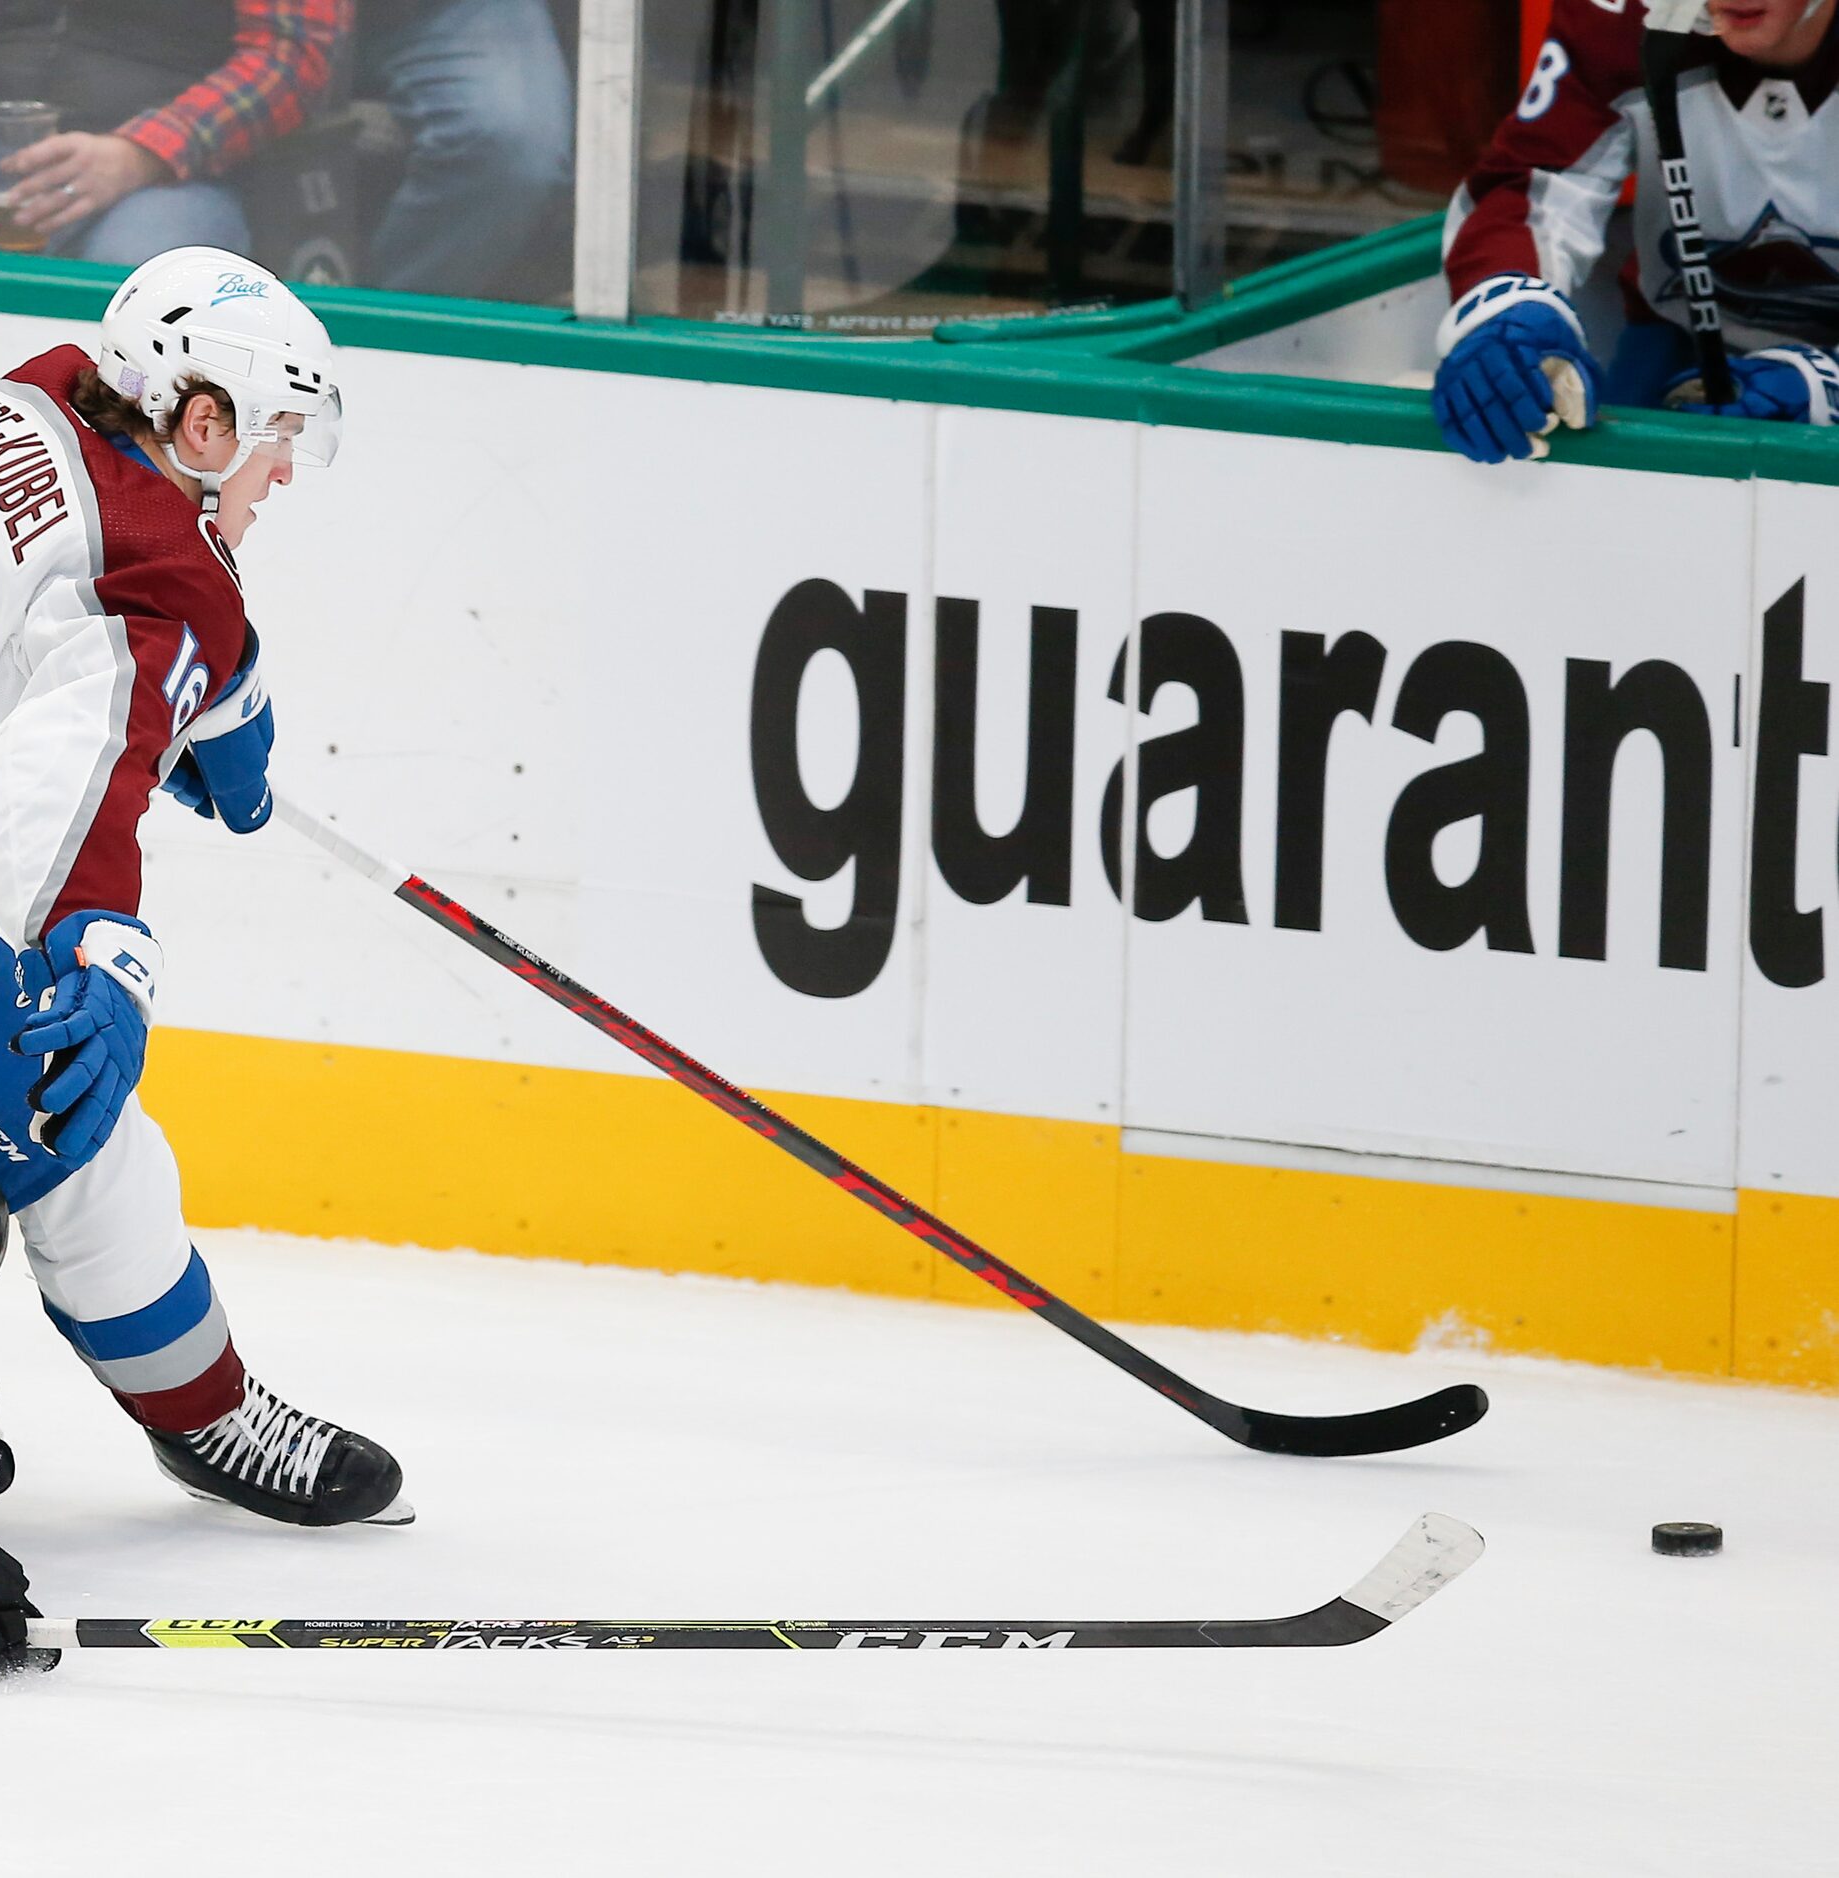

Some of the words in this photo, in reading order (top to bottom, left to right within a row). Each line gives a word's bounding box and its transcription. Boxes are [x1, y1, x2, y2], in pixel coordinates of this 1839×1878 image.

[215, 272, 269, 299] Ball
[161, 621, 210, 742] 16
[750, 577, 1839, 999] guarant
[508, 959, 778, 1138] JETSPEED
[829, 1169, 1049, 1308] CCM
[168, 1619, 267, 1629] CCM
[304, 1621, 365, 1629] ROBERTSON
[319, 1637, 427, 1649] SUPER
[836, 1630, 1076, 1650] CCM
